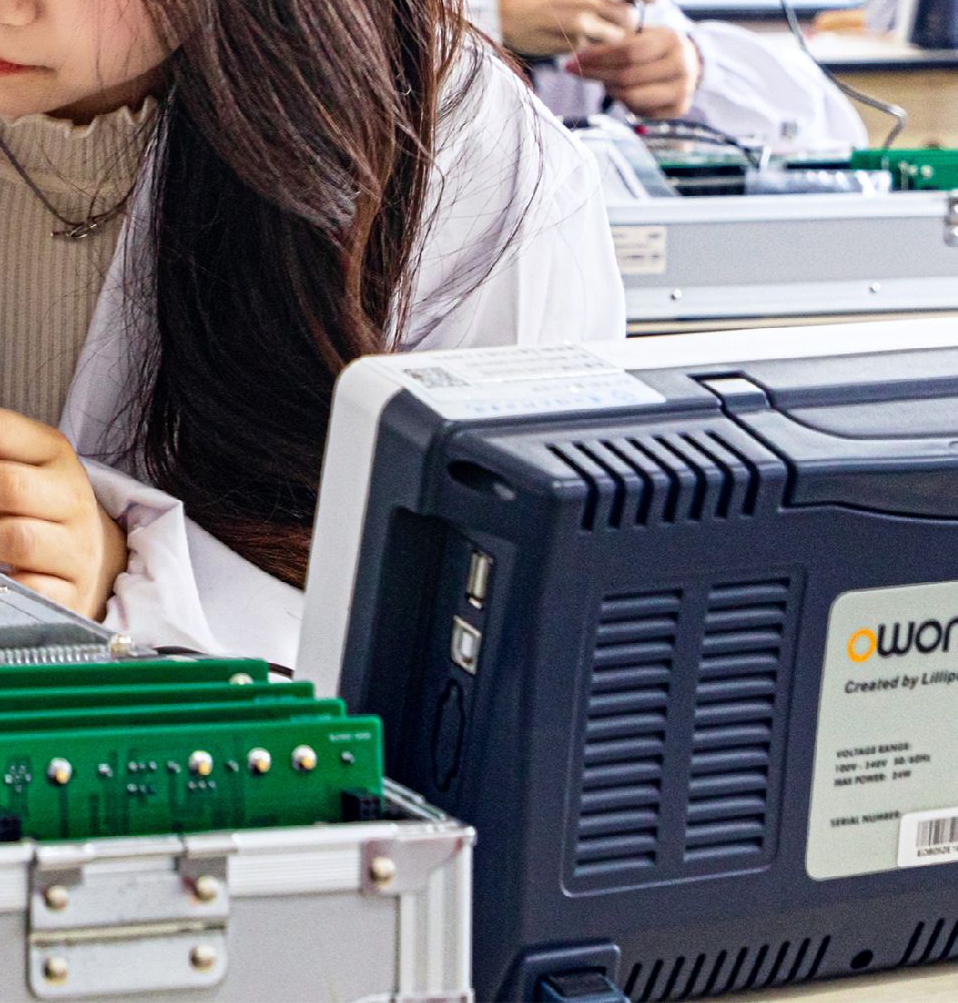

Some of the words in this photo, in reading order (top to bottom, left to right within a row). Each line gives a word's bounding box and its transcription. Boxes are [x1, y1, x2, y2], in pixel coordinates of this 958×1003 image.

[845, 677, 899, 693] Created
[902, 675, 919, 690] by
[830, 816, 859, 827] SERIAL
